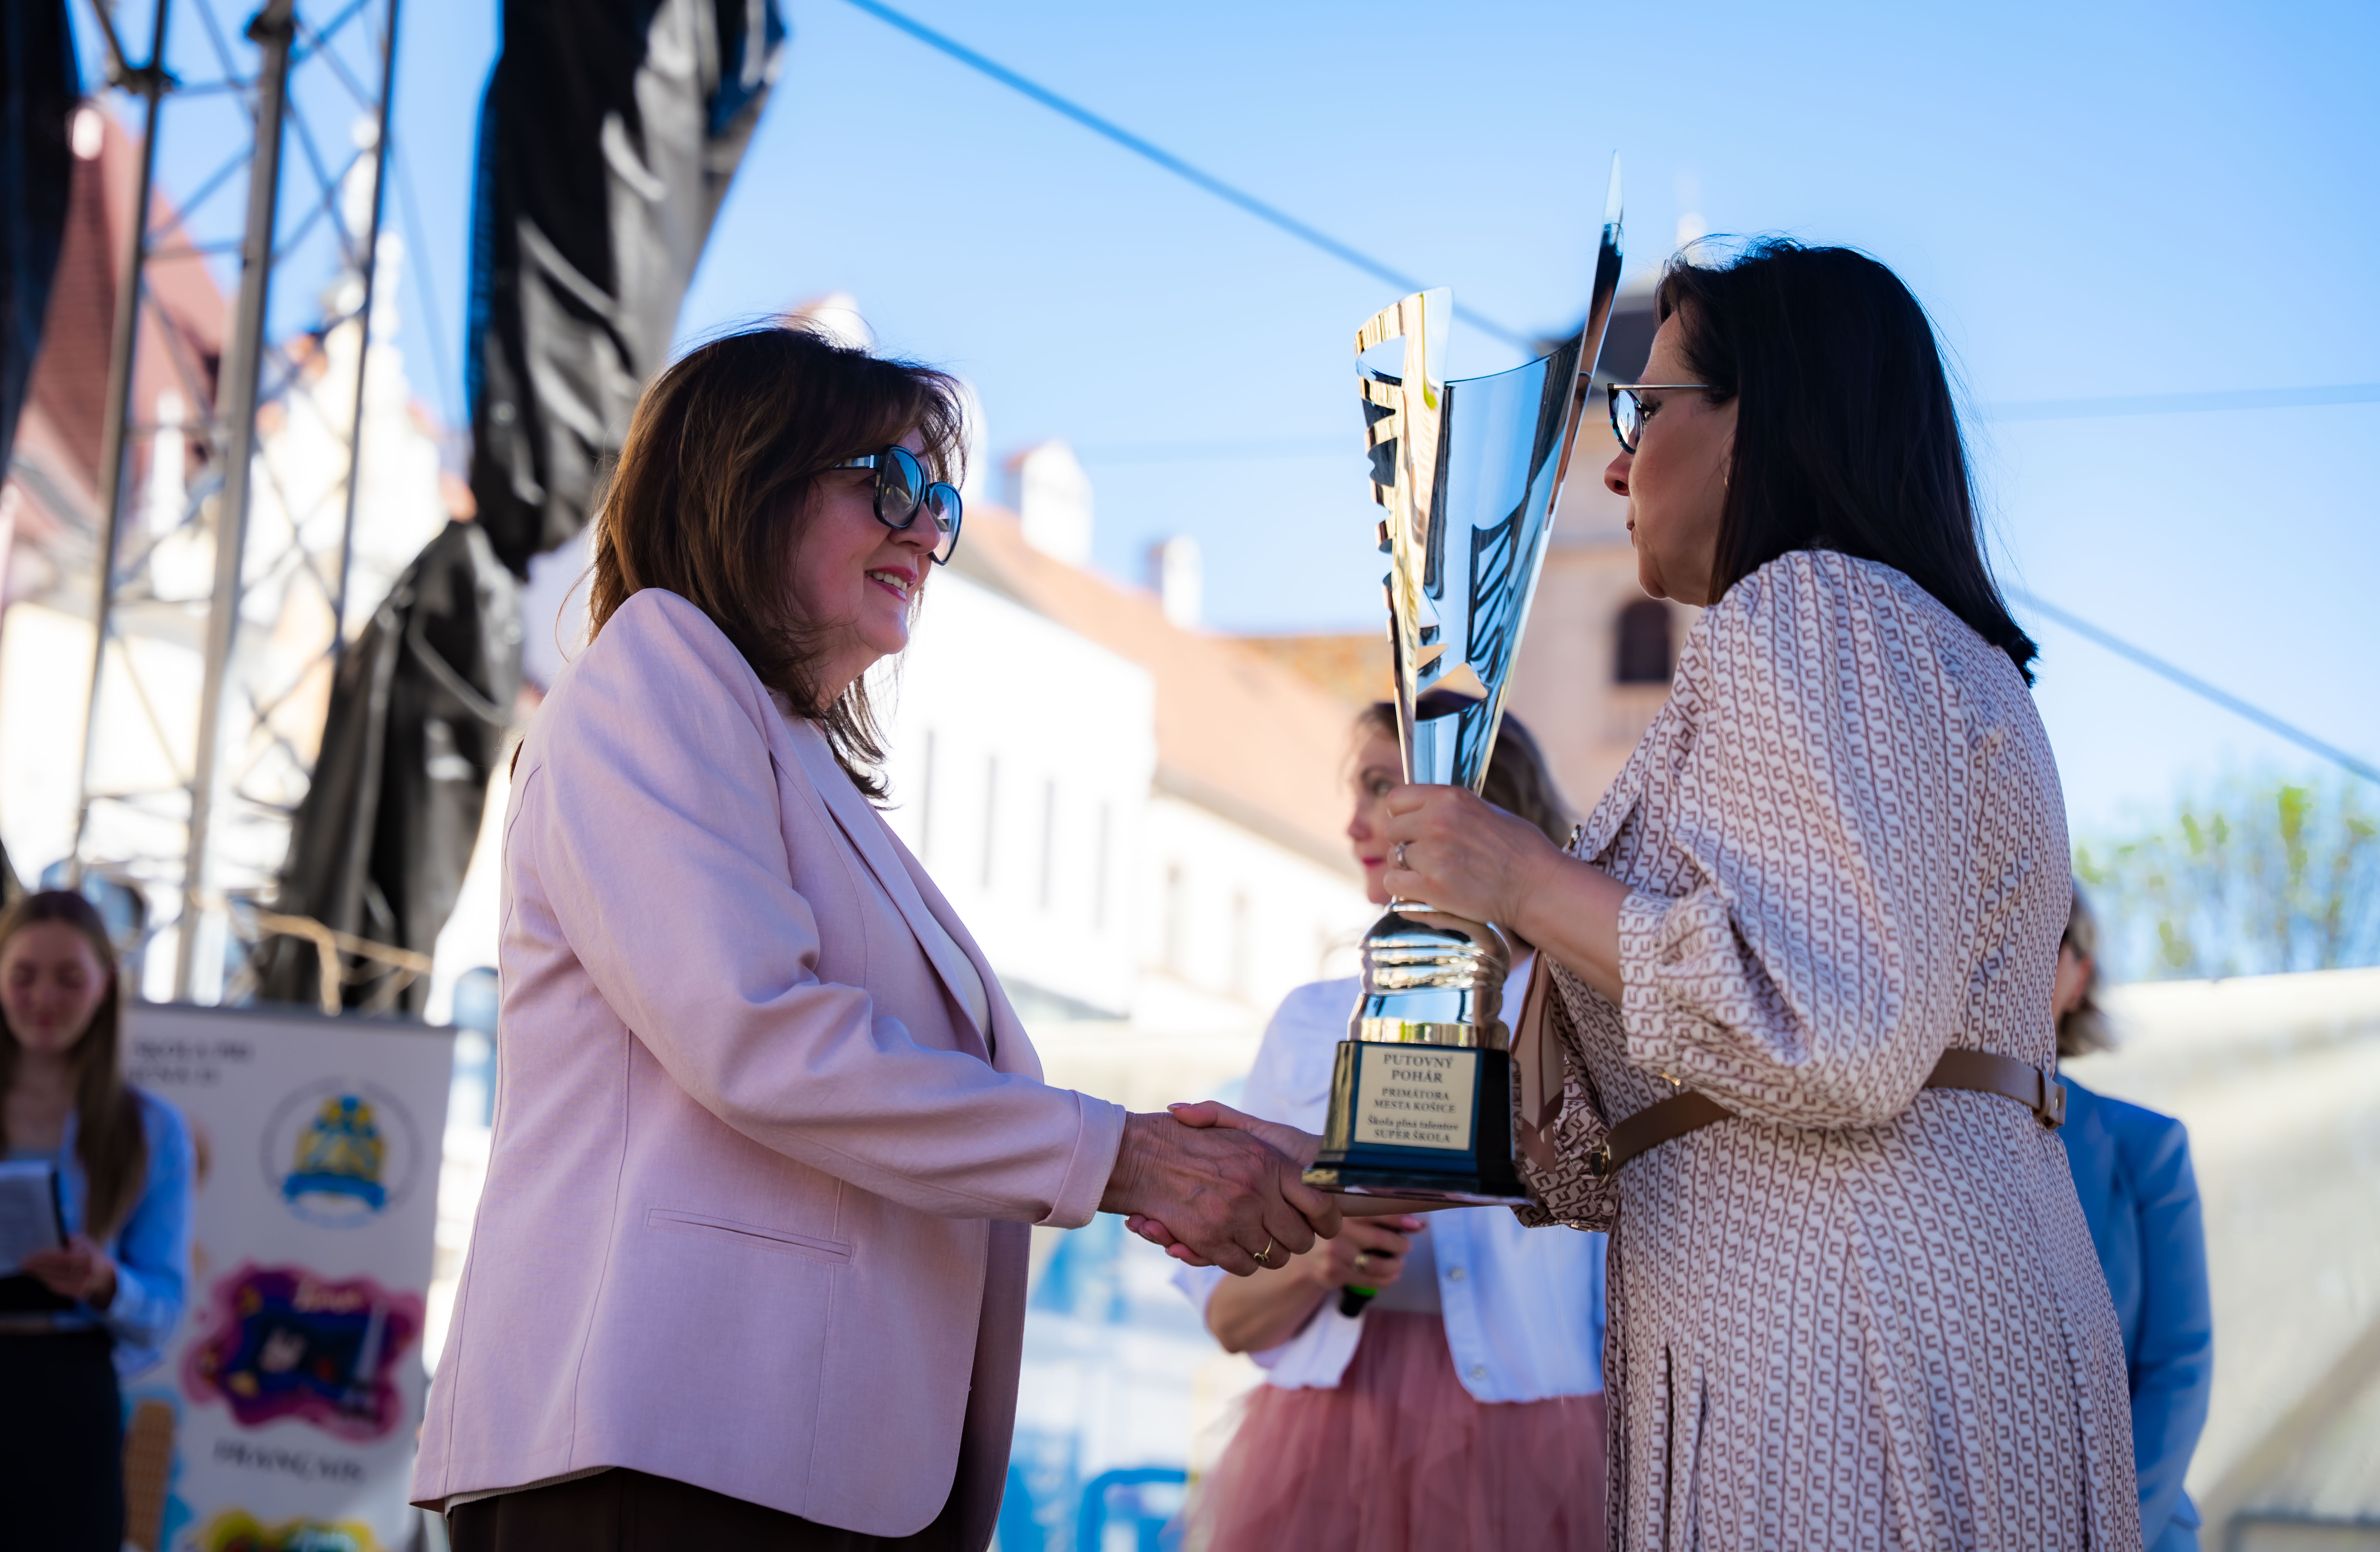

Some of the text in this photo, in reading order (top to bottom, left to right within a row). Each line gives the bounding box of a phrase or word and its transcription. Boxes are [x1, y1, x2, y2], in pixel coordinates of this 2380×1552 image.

[1383, 1053, 1454, 1069] PUTOVNÝ
[1391, 1069, 1443, 1083] POHÁR
[1381, 1087, 1450, 1101] PRIMÁTORA
[1373, 1099, 1456, 1114] MESTA KOŠICE
[1367, 1115, 1460, 1132] Škola plná talentov
[1373, 1128, 1451, 1143] SUPER ŠKOLA
